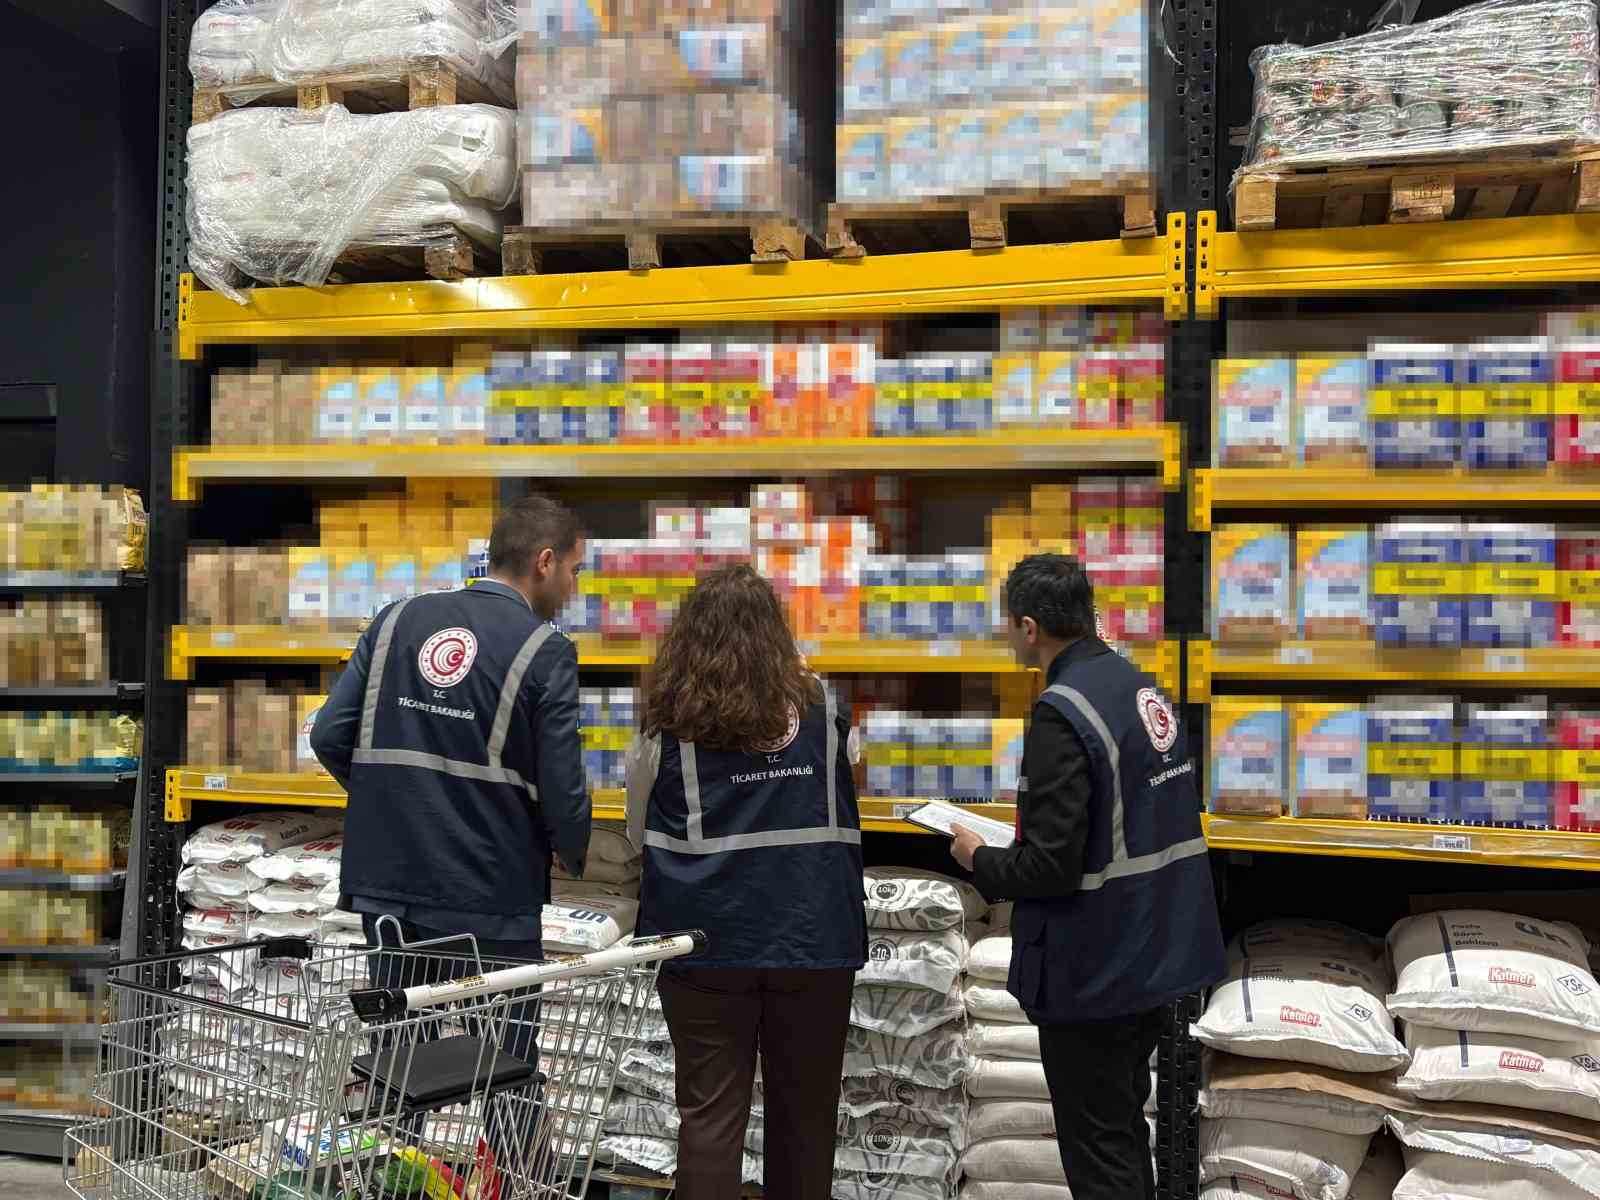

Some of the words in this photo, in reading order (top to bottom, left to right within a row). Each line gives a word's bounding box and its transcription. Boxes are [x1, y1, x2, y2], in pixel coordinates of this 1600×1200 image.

[730, 771, 767, 784] TİCARET
[768, 765, 813, 777] BAKANLIĞI
[1488, 967, 1536, 986] Katmer
[1280, 1006, 1321, 1027] Katmer
[1499, 1051, 1543, 1072] Katmer
